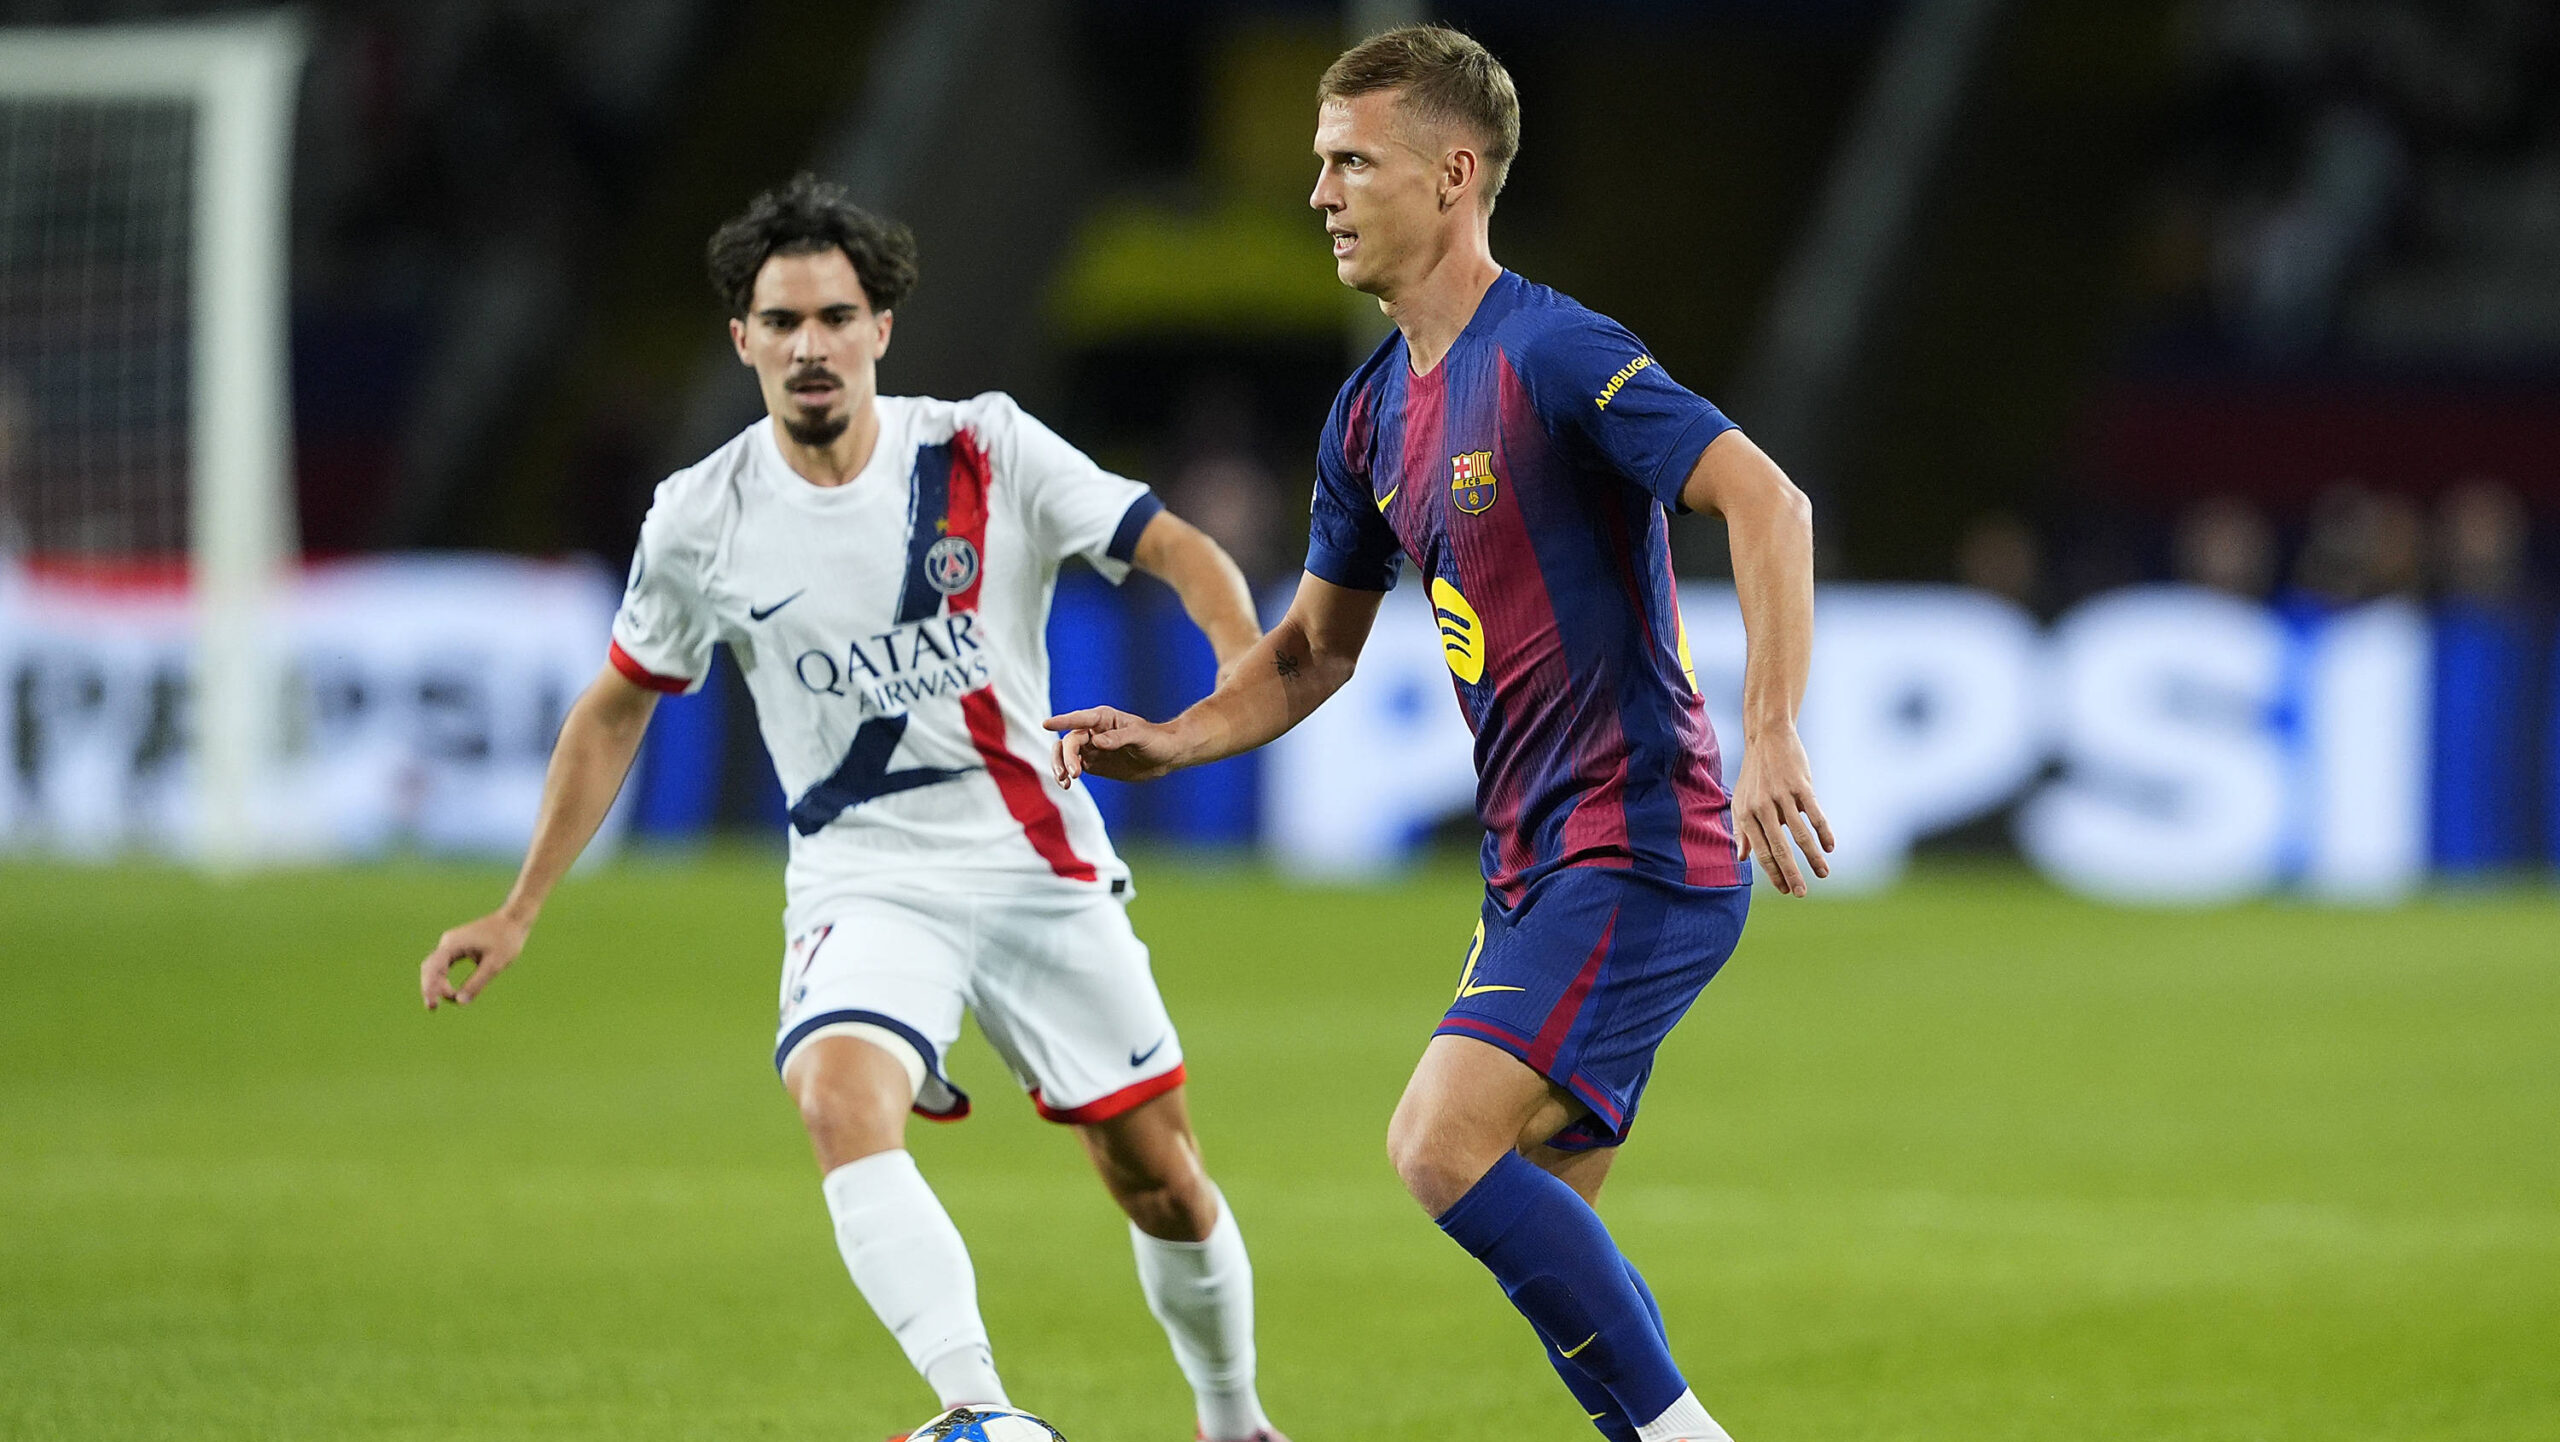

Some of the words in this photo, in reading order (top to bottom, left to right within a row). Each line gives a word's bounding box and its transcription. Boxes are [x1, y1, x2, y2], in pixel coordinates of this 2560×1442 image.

[1463, 477, 1480, 486] FCB
[796, 614, 979, 698] QATAR
[859, 655, 988, 713] AIRWAYS
[1262, 582, 2437, 908] PPSI
